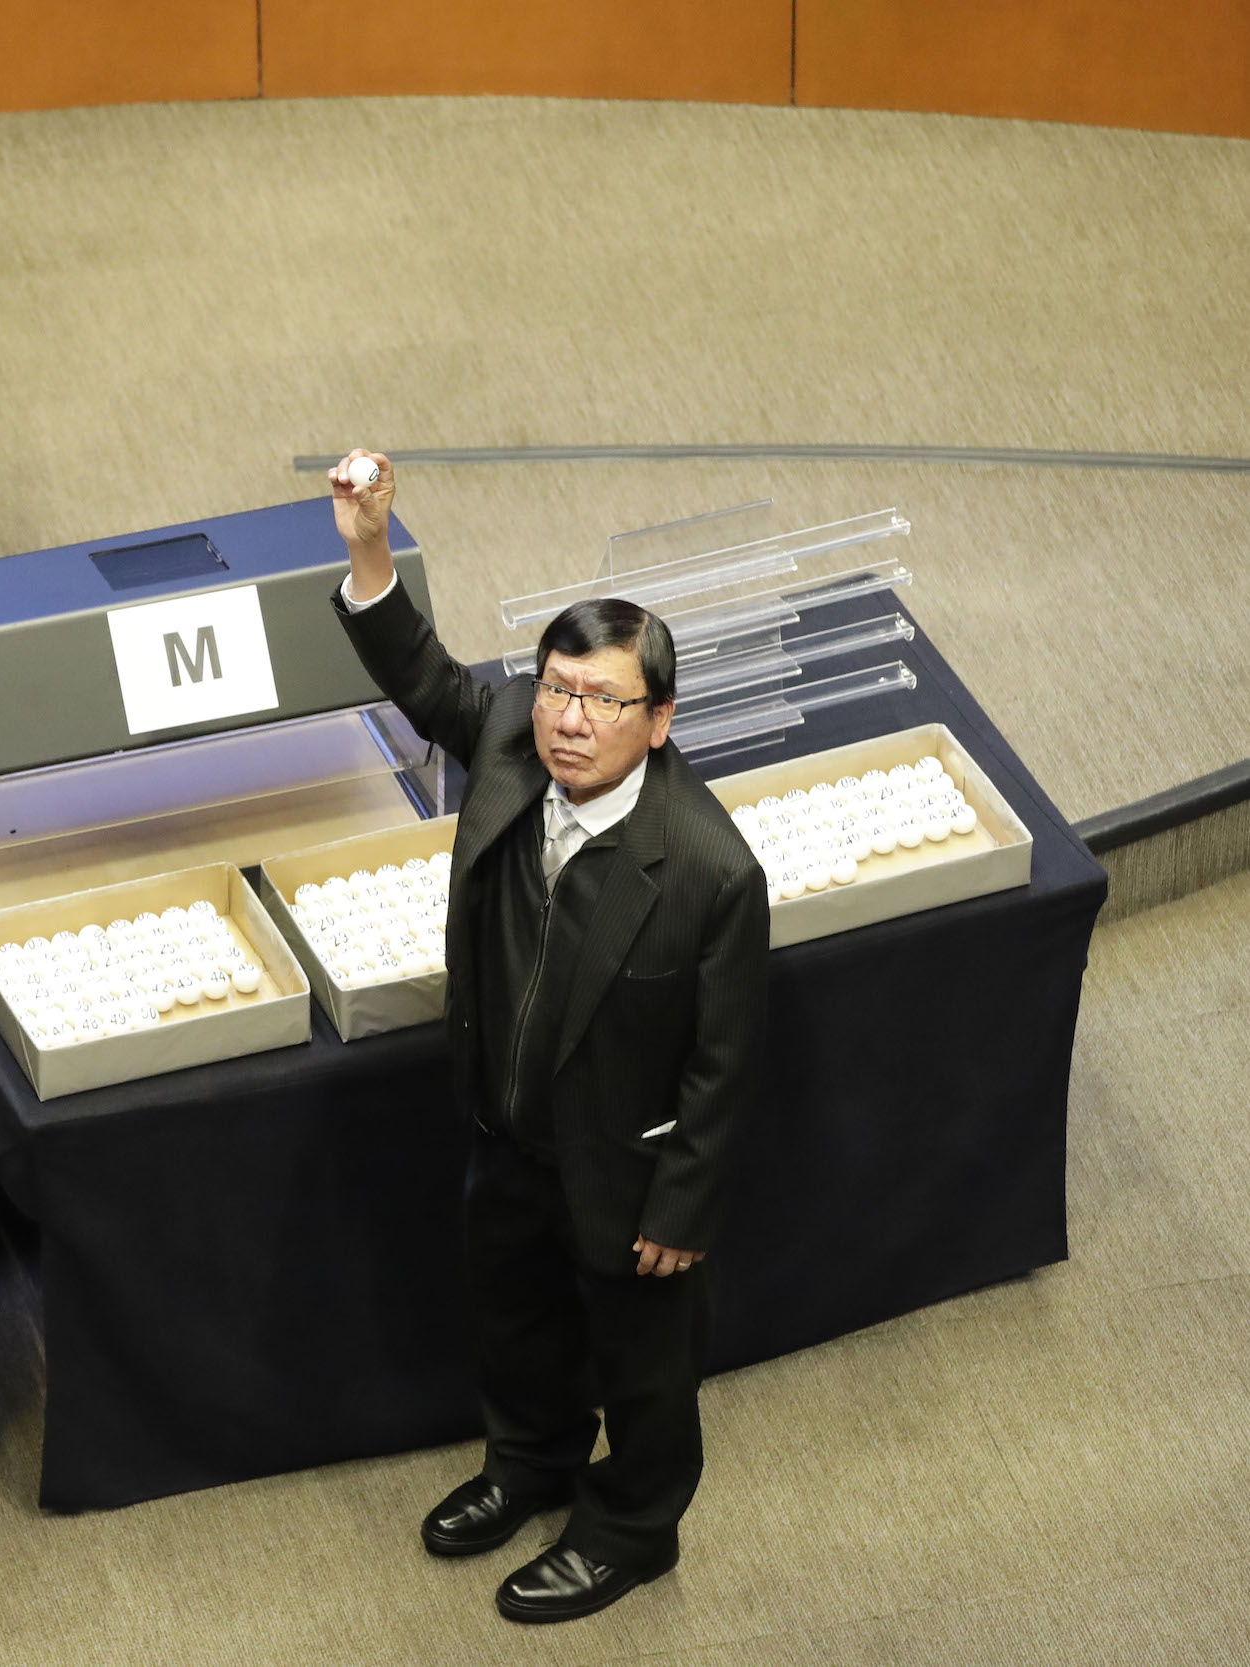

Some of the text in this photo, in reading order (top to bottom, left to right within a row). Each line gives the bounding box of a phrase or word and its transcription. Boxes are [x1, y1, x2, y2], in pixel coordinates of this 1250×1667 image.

[163, 625, 223, 688] M
[429, 892, 447, 907] 24
[320, 916, 335, 932] 20
[211, 971, 226, 982] 44
